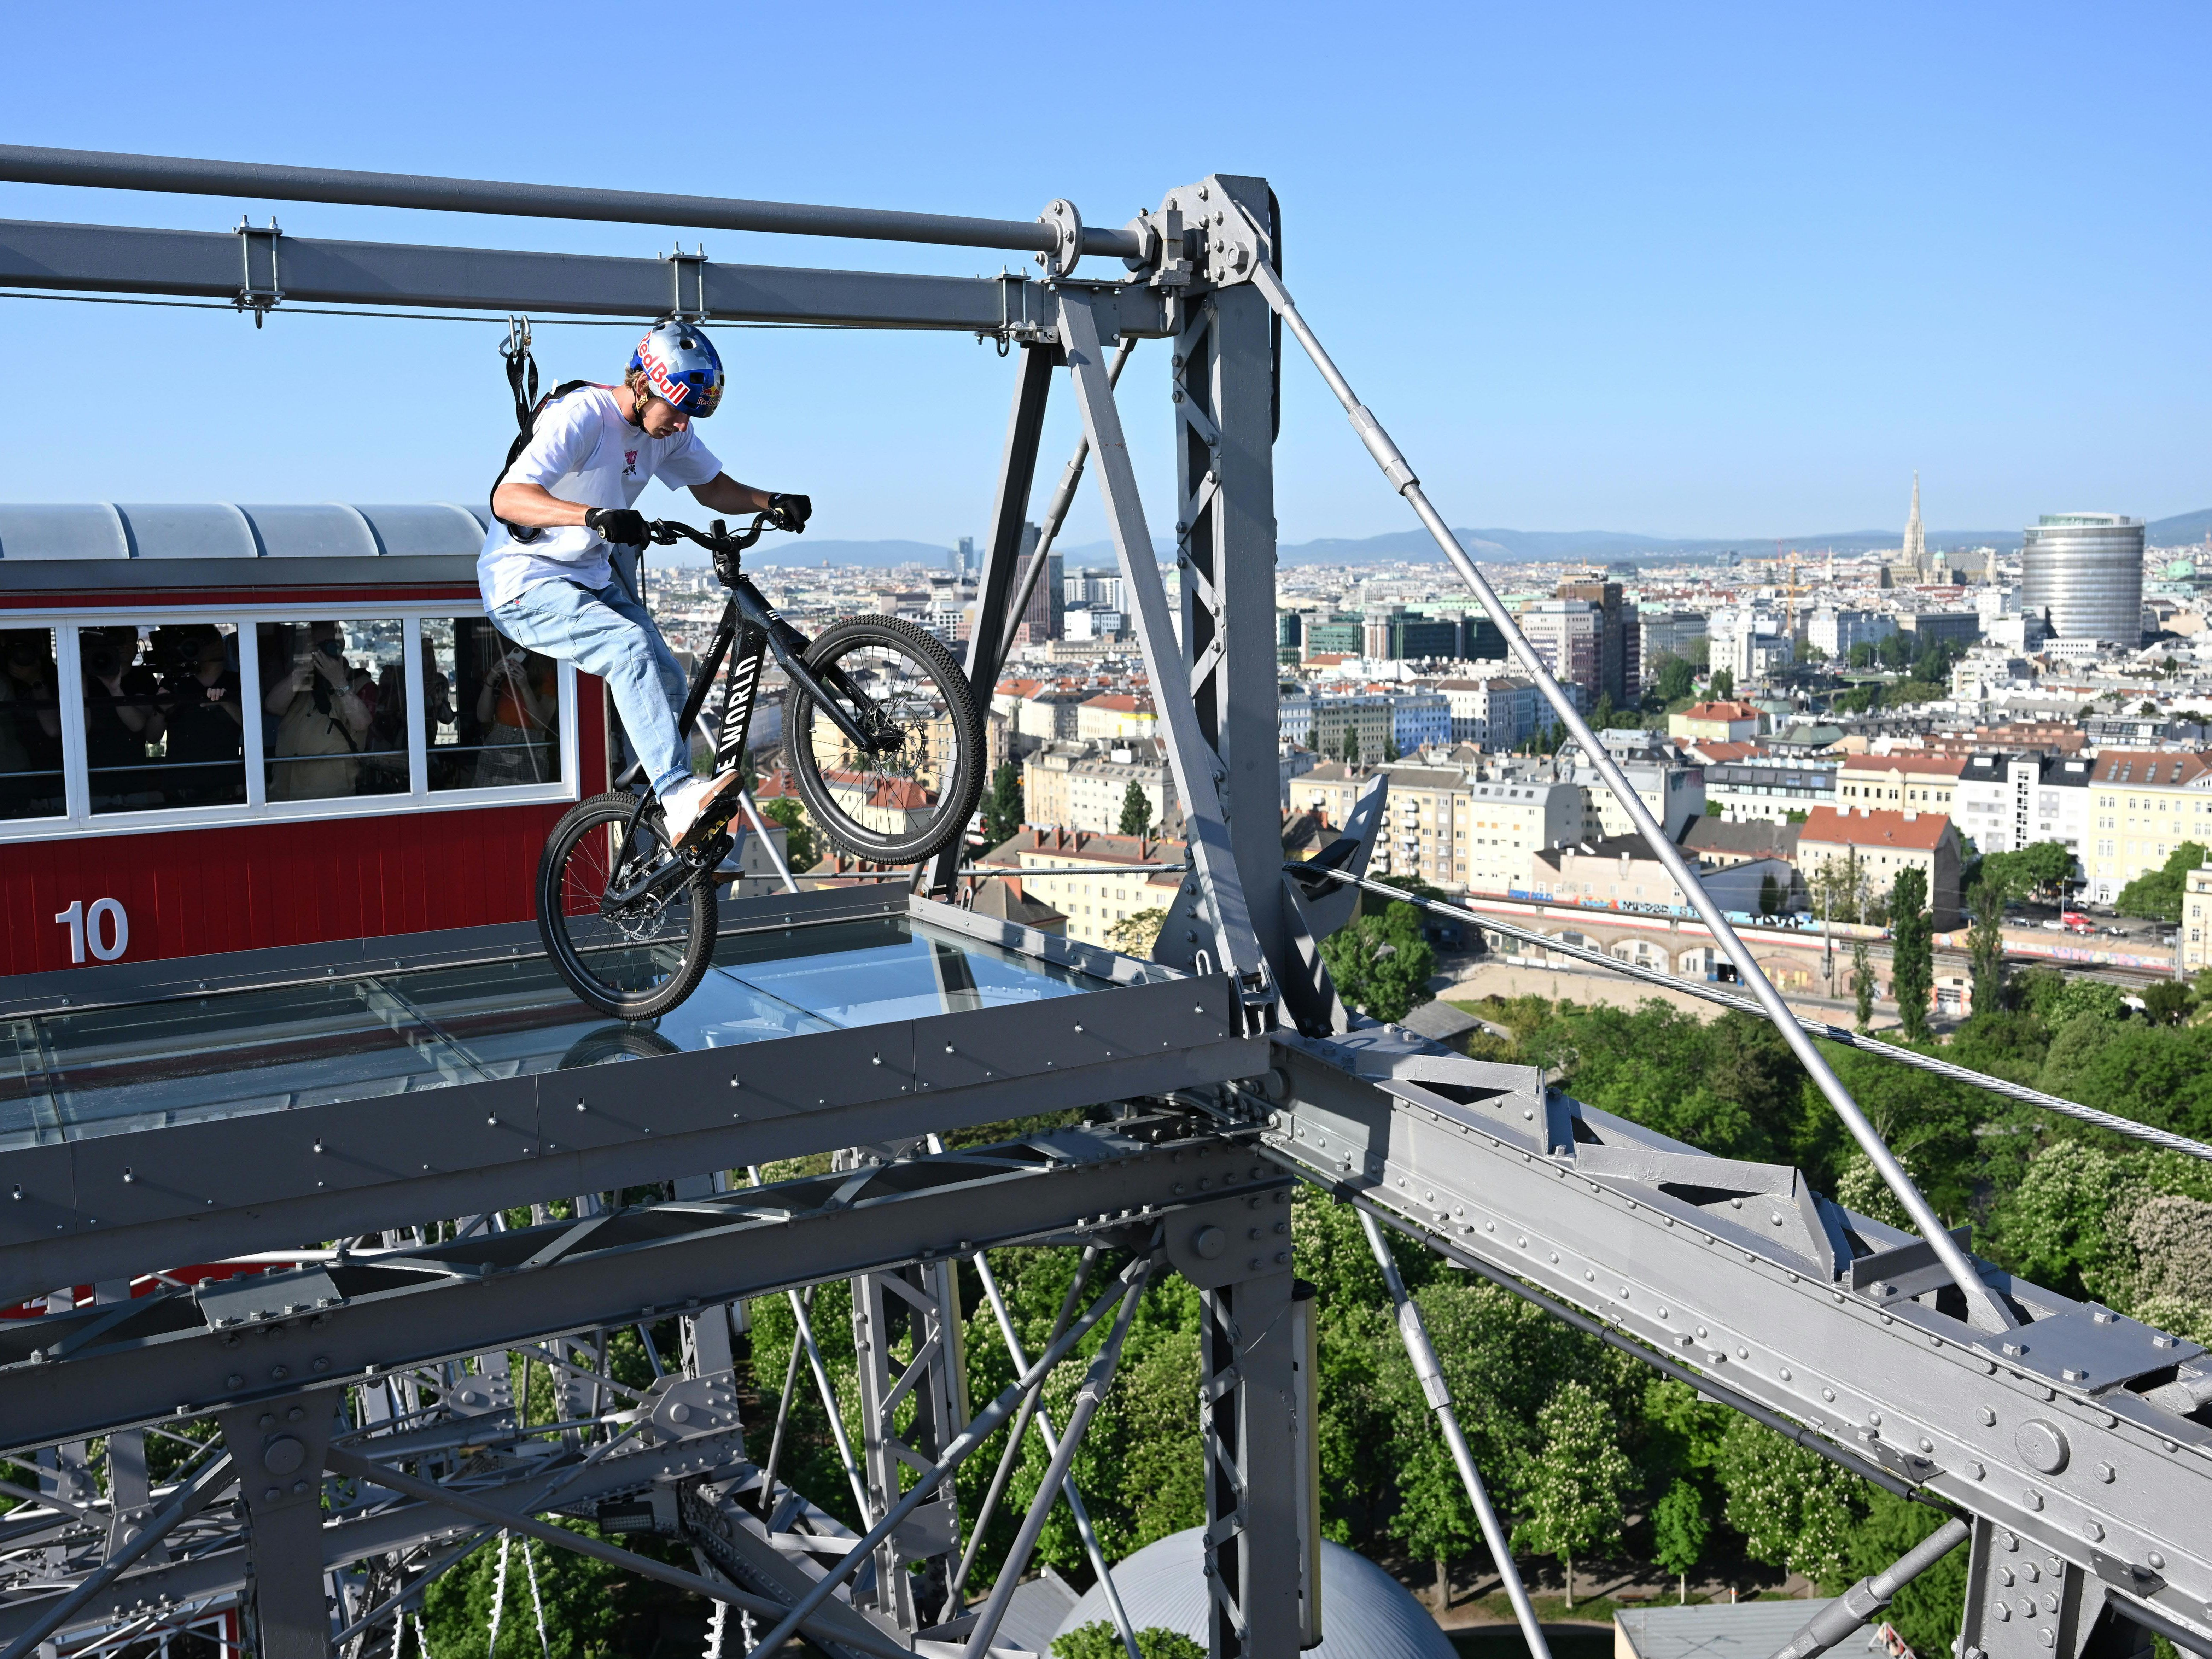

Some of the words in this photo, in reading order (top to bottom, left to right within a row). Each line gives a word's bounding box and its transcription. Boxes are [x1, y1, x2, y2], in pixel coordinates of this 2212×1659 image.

[637, 330, 660, 370] Red
[650, 361, 689, 405] Bull
[697, 397, 710, 405] Red
[707, 635, 721, 657] CANYON
[719, 655, 758, 753] WORLD
[55, 898, 129, 964] 10
